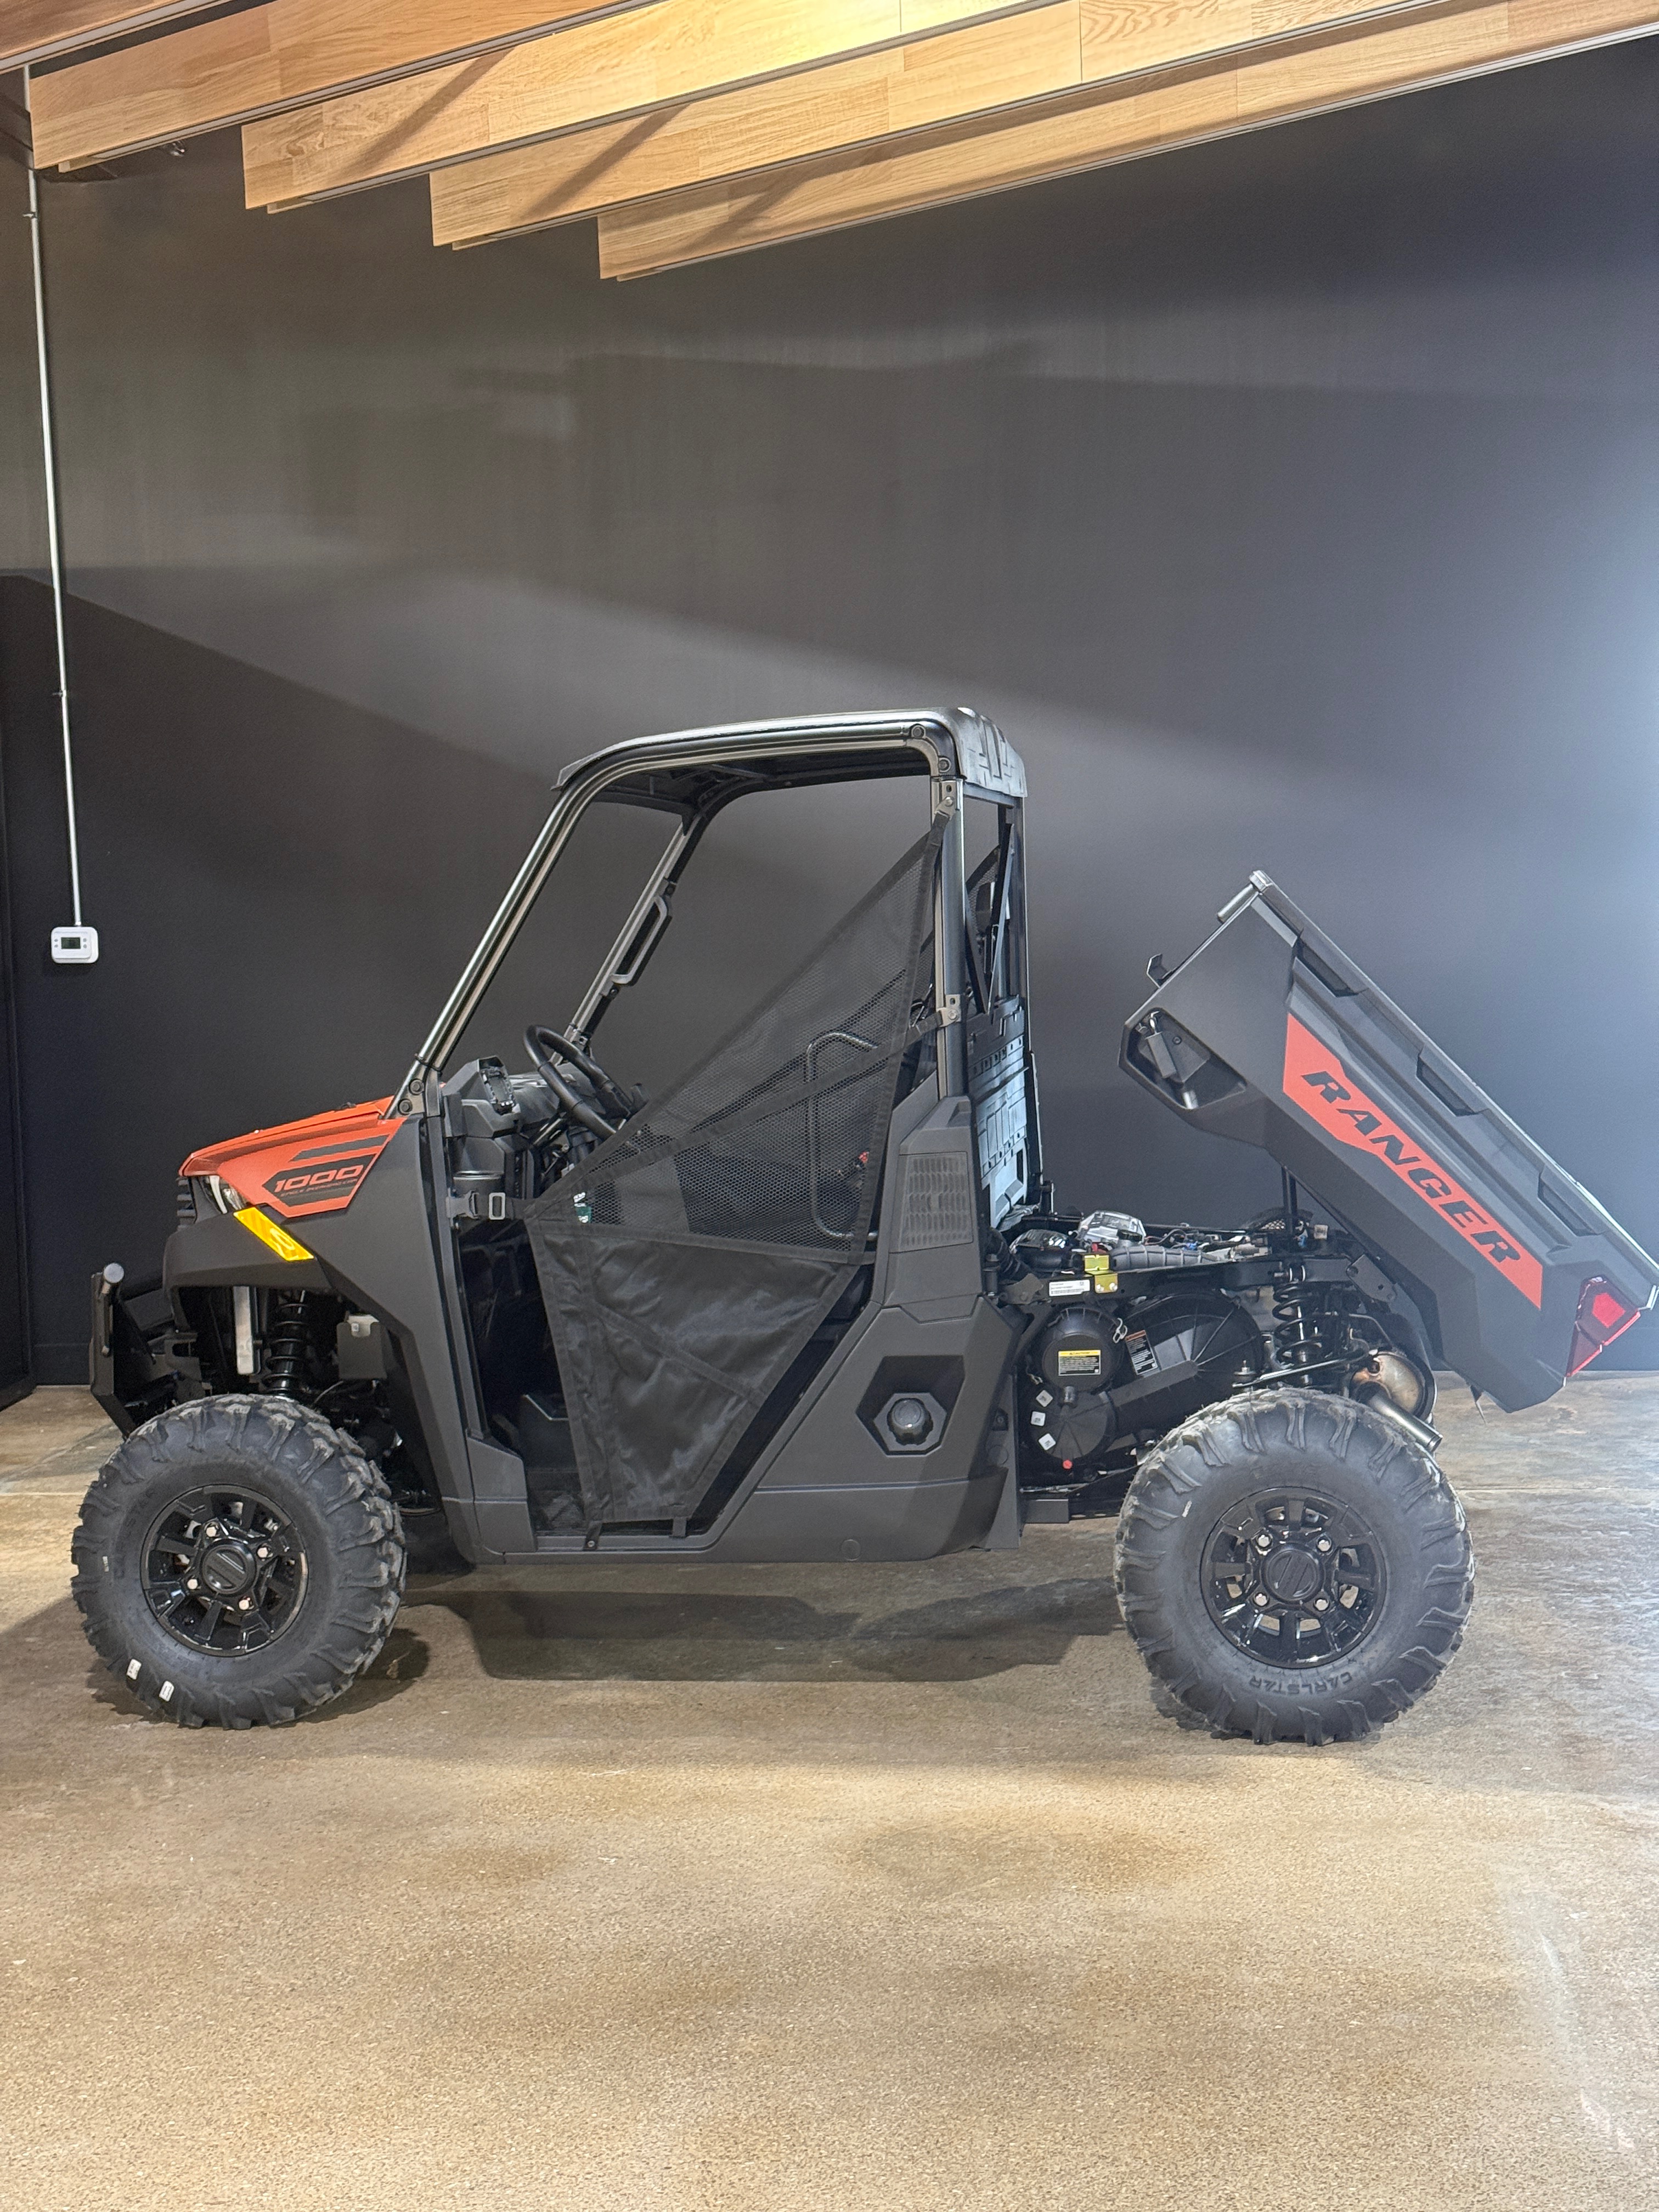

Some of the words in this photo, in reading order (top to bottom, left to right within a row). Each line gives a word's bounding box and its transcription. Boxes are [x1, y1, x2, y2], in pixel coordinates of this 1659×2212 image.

[274, 1165, 363, 1193] 1000
[1301, 1070, 1521, 1263] RANGER
[1248, 1671, 1352, 1695] CARLSTAR
